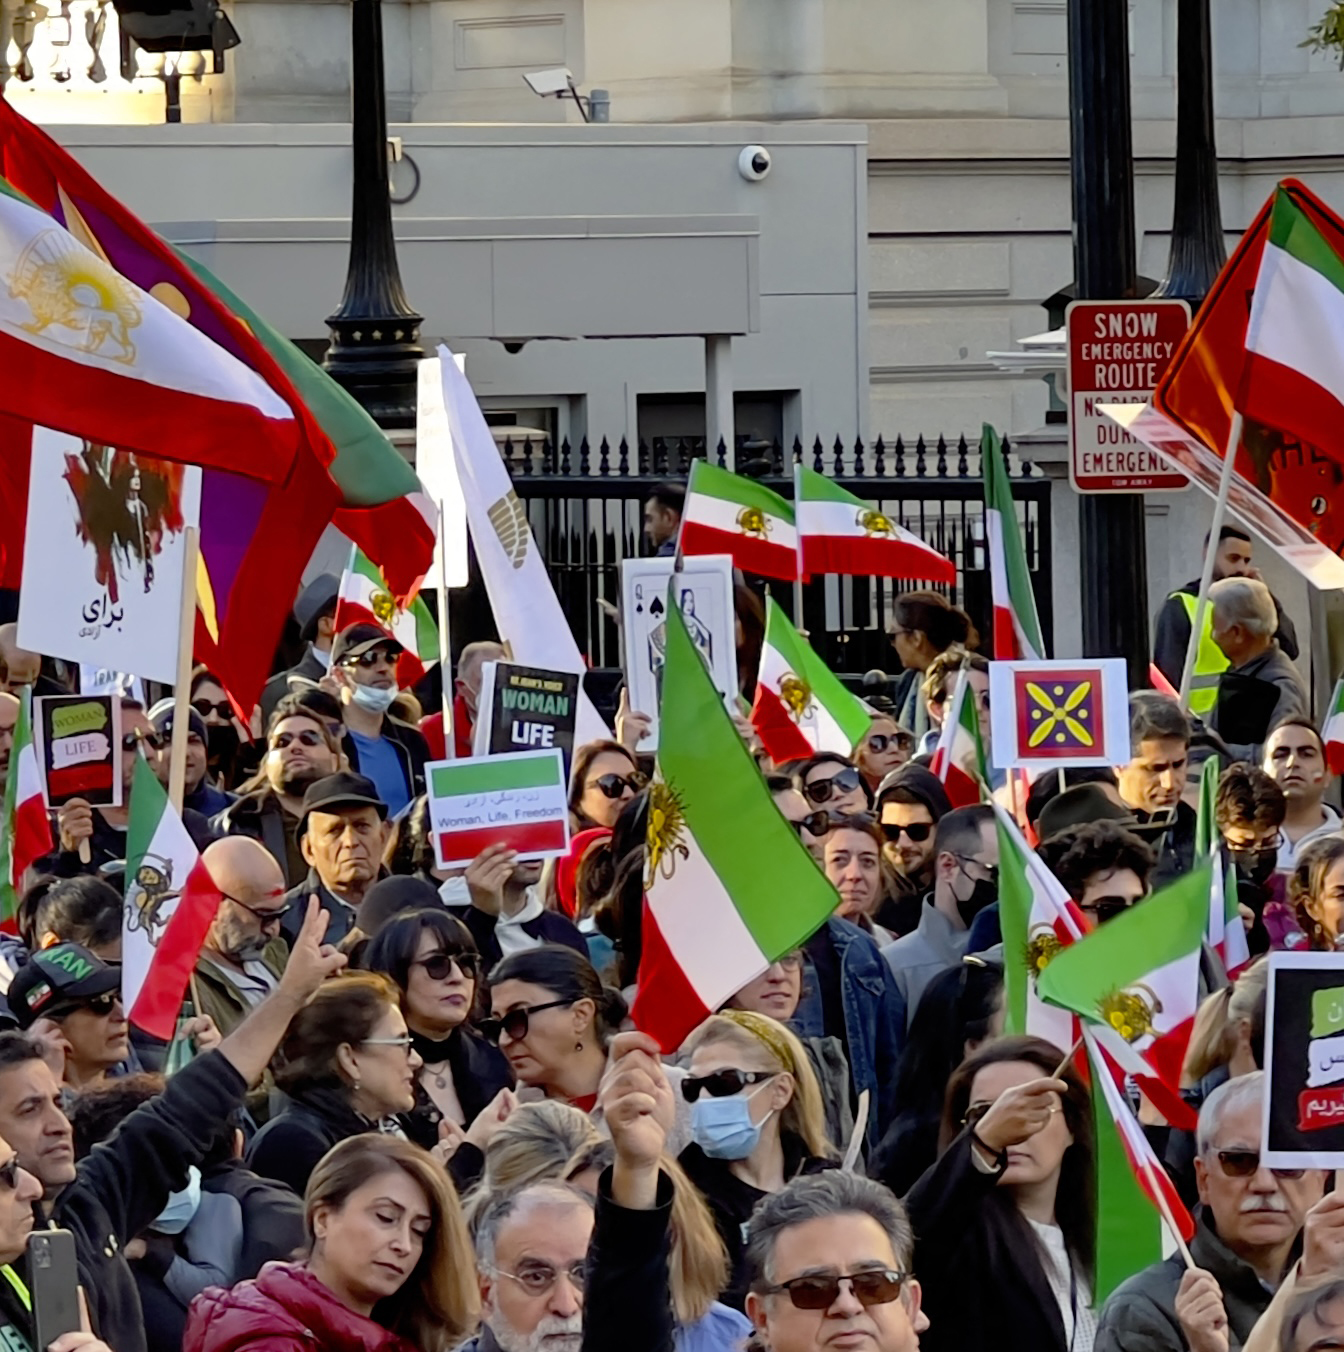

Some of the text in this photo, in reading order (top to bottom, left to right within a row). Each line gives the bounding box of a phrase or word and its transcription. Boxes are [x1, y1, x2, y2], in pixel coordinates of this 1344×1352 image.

[1094, 312, 1158, 339] SNOW
[1081, 342, 1174, 361] EMERGENCY
[1094, 363, 1158, 389] ROUTE
[501, 688, 569, 717] WOMAN
[54, 708, 103, 729] WOMAN
[511, 720, 555, 747] LIFE
[64, 739, 97, 756] LIFE
[438, 806, 563, 828] Woman, Life, Freedom
